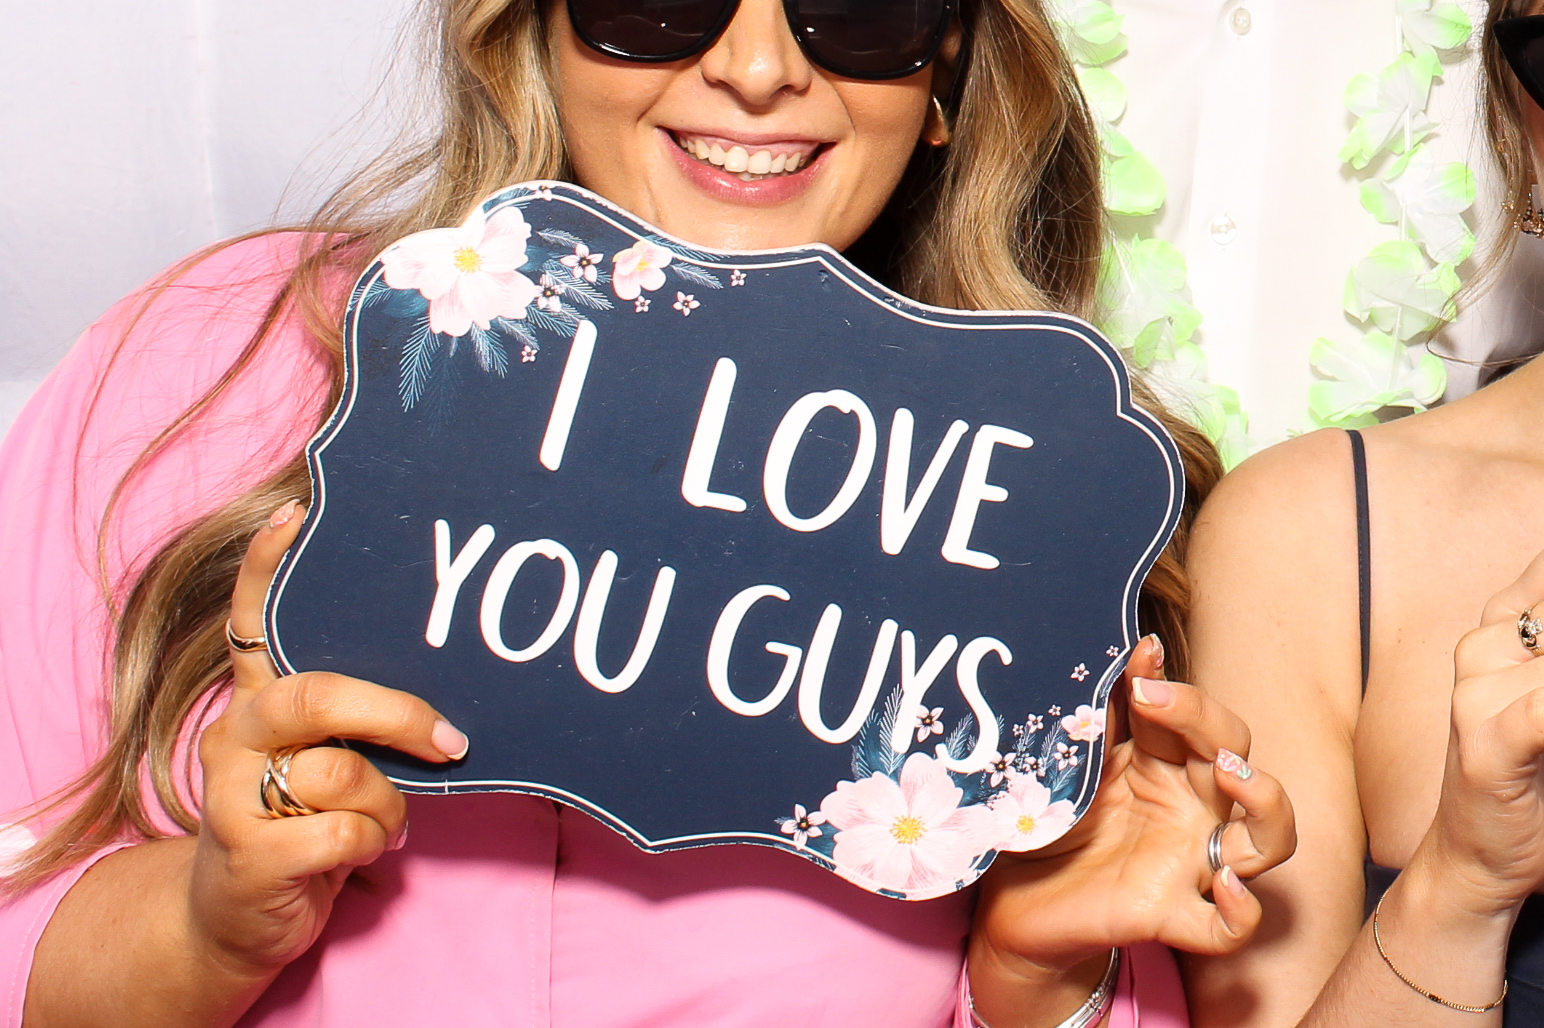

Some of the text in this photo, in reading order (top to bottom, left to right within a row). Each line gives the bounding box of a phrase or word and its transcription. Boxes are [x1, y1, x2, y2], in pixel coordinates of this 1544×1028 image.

[538, 318, 1034, 569] I LOVE
[425, 519, 1013, 774] YOU GUYS
